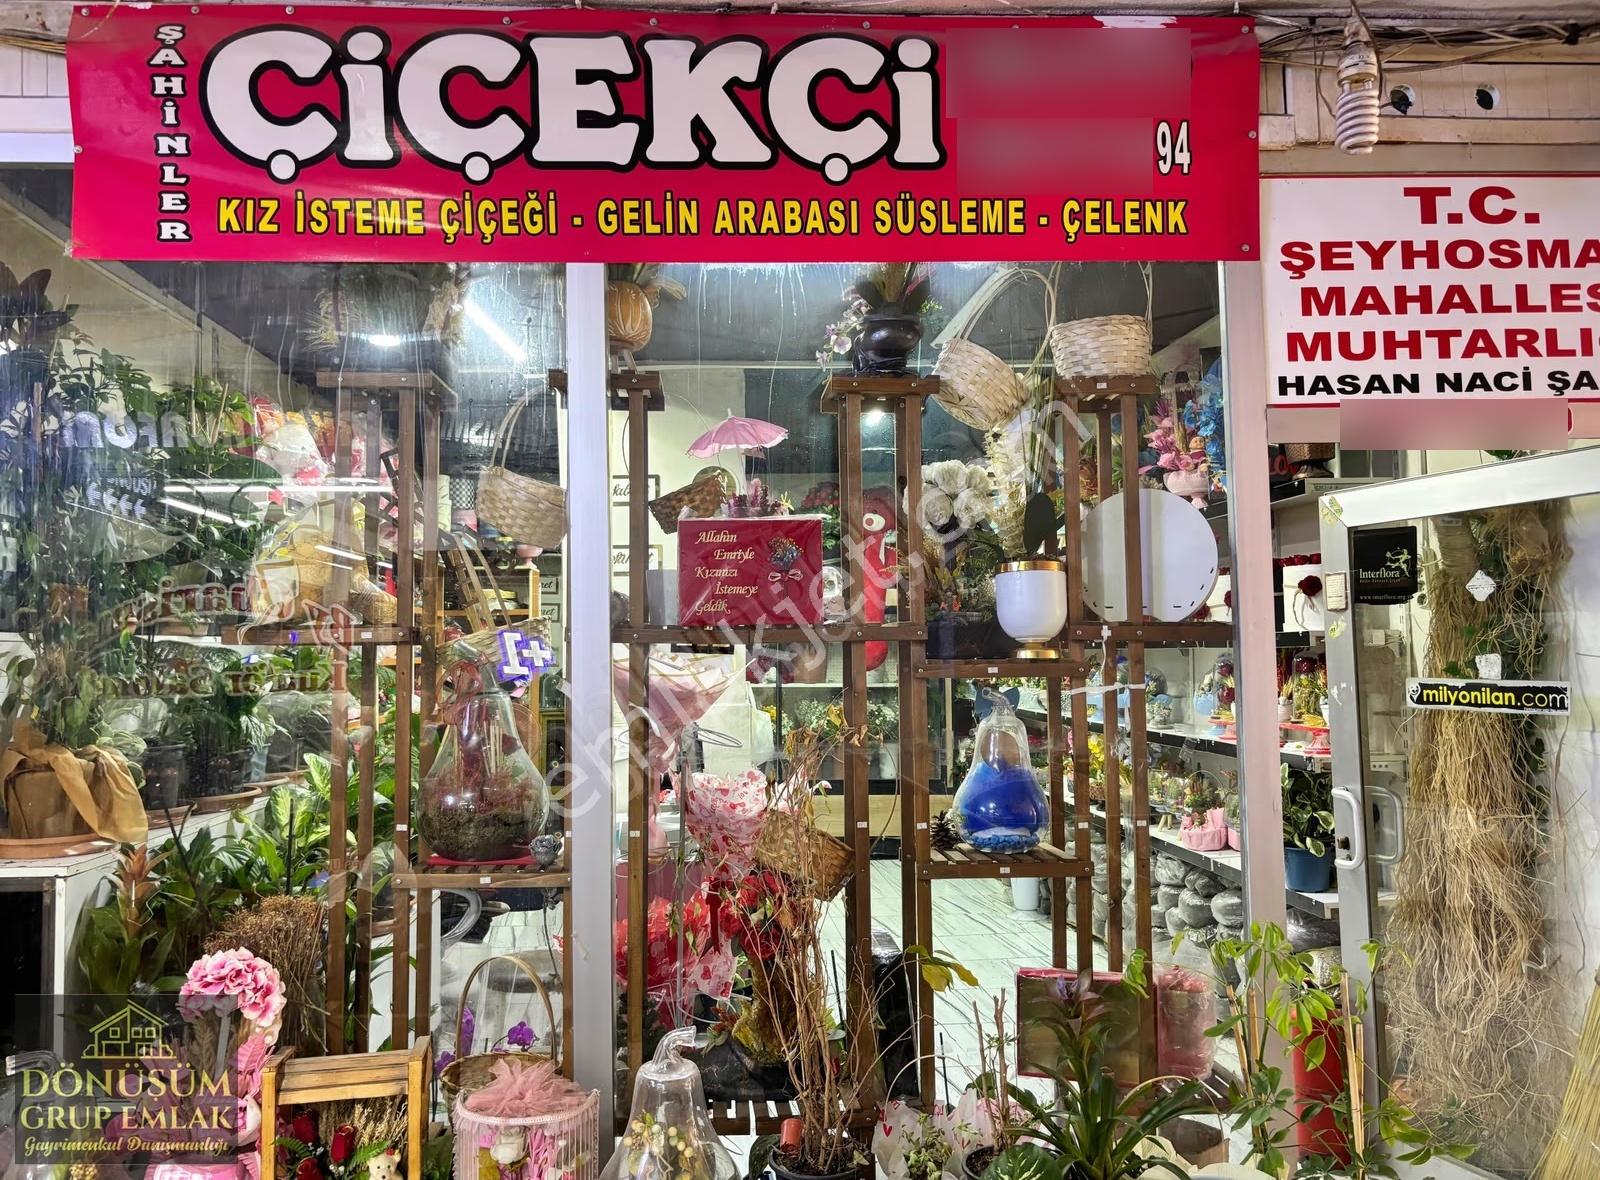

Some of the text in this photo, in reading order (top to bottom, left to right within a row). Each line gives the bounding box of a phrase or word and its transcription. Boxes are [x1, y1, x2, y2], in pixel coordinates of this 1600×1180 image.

[1155, 120, 1192, 175] 94
[218, 197, 279, 233] KIZ
[295, 190, 425, 235] İSTEME
[440, 191, 558, 244] ÇİÇEĞİ
[596, 191, 699, 235] GELİN
[712, 200, 859, 235] ARABASI
[874, 192, 1025, 235] SÜSLEME
[1062, 199, 1188, 242] ÇELENK
[1404, 186, 1541, 225] T.C.
[1286, 327, 1600, 362] MUHTARLI
[1277, 372, 1420, 396] HASAN
[1435, 366, 1532, 393] NACİ
[713, 547, 755, 563] Emriyle
[1359, 567, 1401, 579] Interflora
[714, 581, 759, 597] İstemeye
[695, 599, 732, 615] Geldik
[1422, 686, 1569, 708] milyonilan.com
